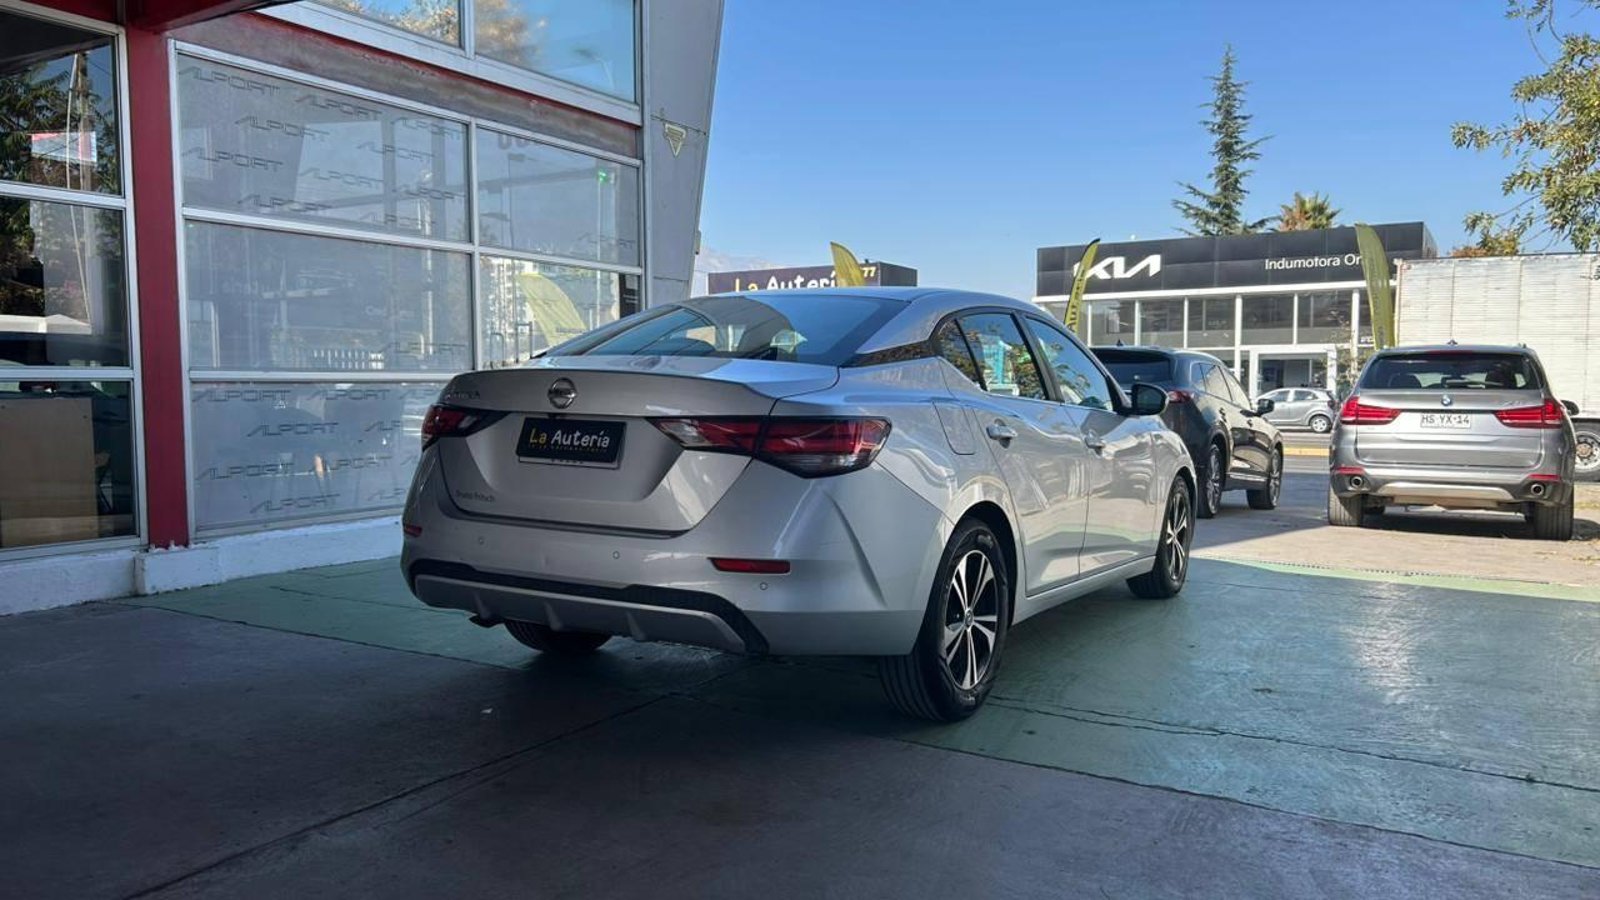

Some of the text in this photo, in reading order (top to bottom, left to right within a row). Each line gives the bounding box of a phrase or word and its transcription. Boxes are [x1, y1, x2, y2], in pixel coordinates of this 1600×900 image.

[180, 66, 280, 96] ALPORT
[295, 94, 383, 121] ALPORT
[234, 115, 331, 143] ALPORT
[181, 147, 284, 173] ALPORT
[1264, 256, 1340, 270] Indumotora
[766, 271, 837, 291] Auterí
[192, 389, 291, 402] ALPORT
[246, 421, 339, 438] ALPORT
[529, 427, 548, 445] La
[550, 429, 611, 449] Autería
[195, 462, 295, 482] ALPORT
[250, 493, 341, 514] ALPORT
